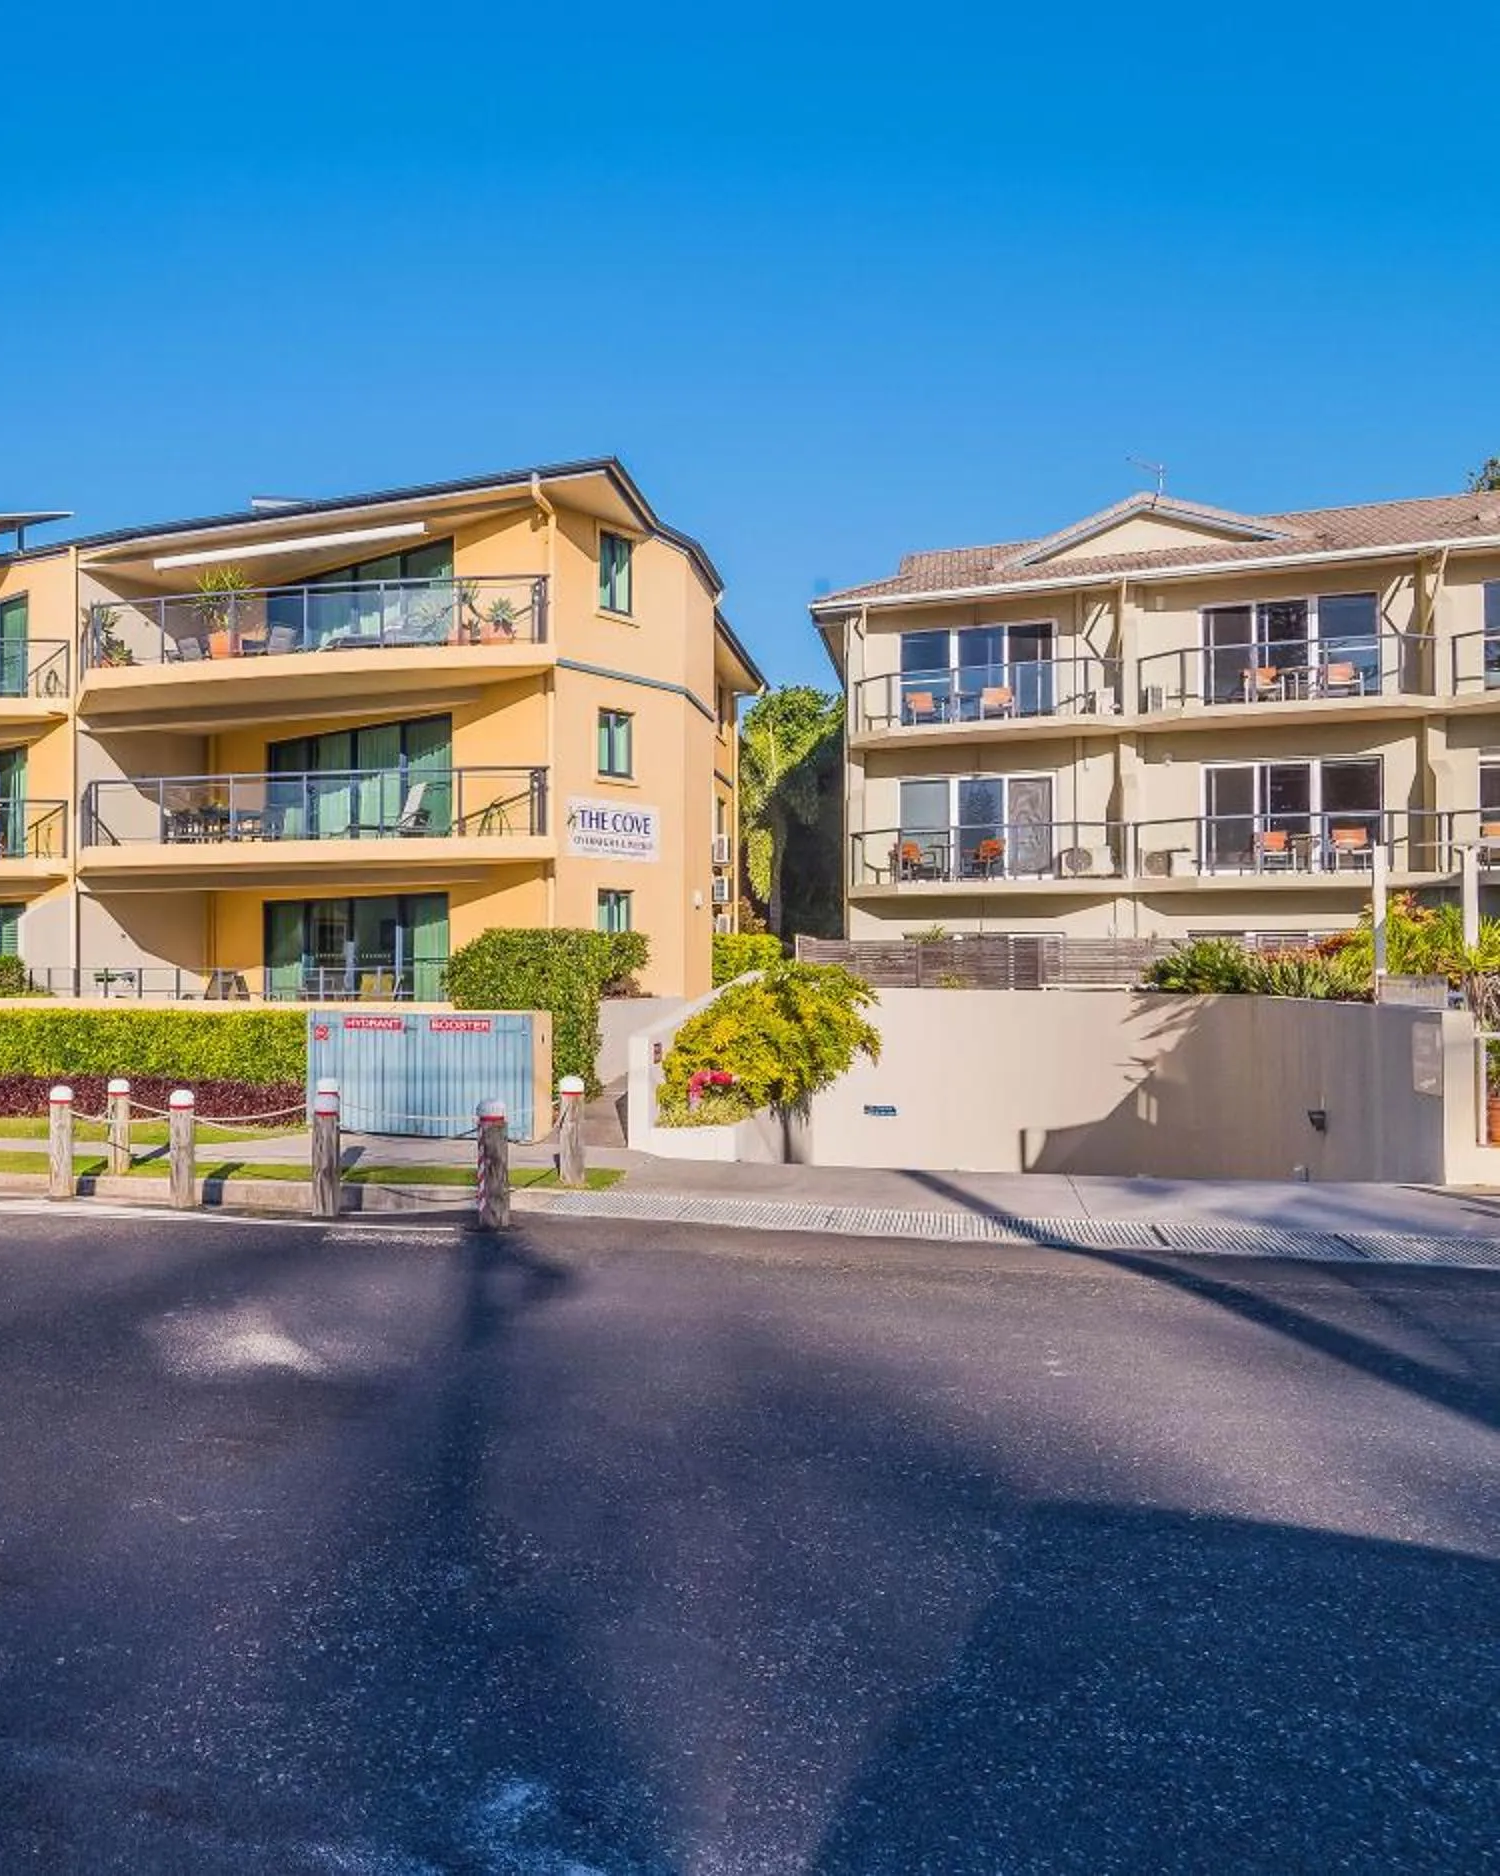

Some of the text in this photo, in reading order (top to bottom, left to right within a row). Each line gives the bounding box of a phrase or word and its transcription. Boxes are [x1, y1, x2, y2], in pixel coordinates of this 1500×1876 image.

[580, 810, 651, 834] THE COVE
[346, 1018, 400, 1029] HYDRANT
[431, 1020, 489, 1032] BOOSTER
